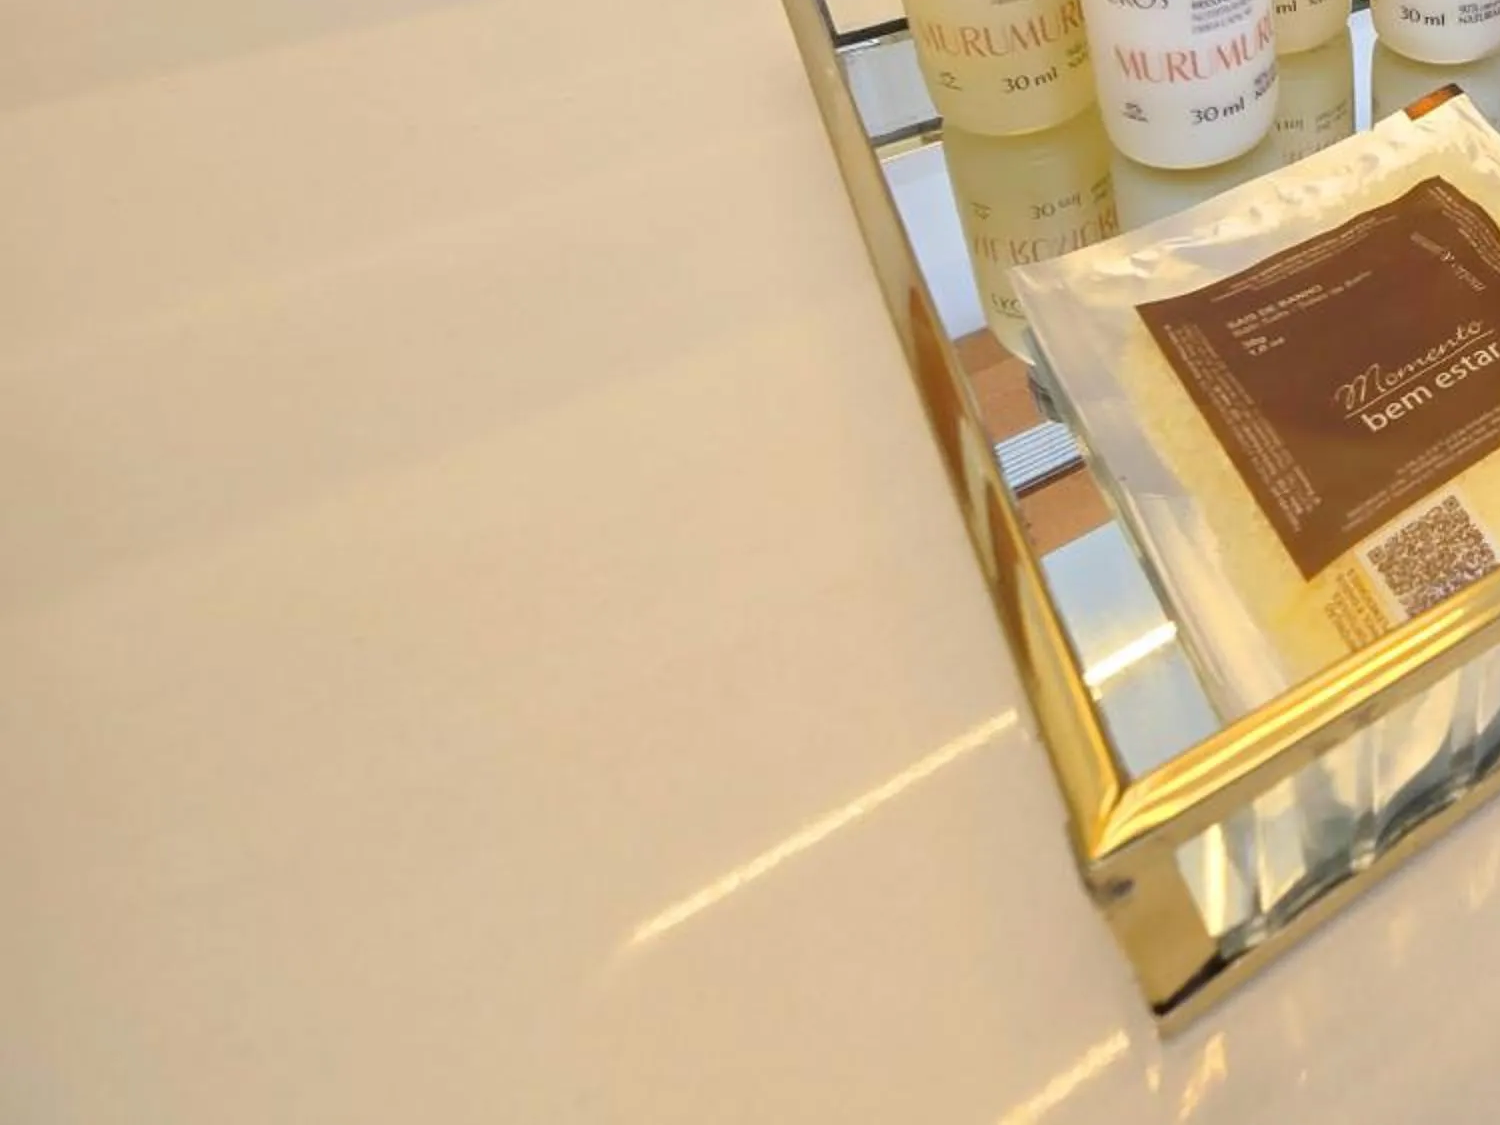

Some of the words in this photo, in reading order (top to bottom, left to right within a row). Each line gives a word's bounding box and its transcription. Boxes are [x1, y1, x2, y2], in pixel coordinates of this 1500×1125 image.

[1400, 4, 1421, 24] 30
[1424, 12, 1446, 27] ml
[1003, 74, 1030, 94] 30
[1034, 66, 1058, 88] ml
[1190, 106, 1220, 125] 30
[1222, 96, 1246, 118] ml
[1333, 319, 1484, 411] Momento
[1361, 383, 1434, 434] bem
